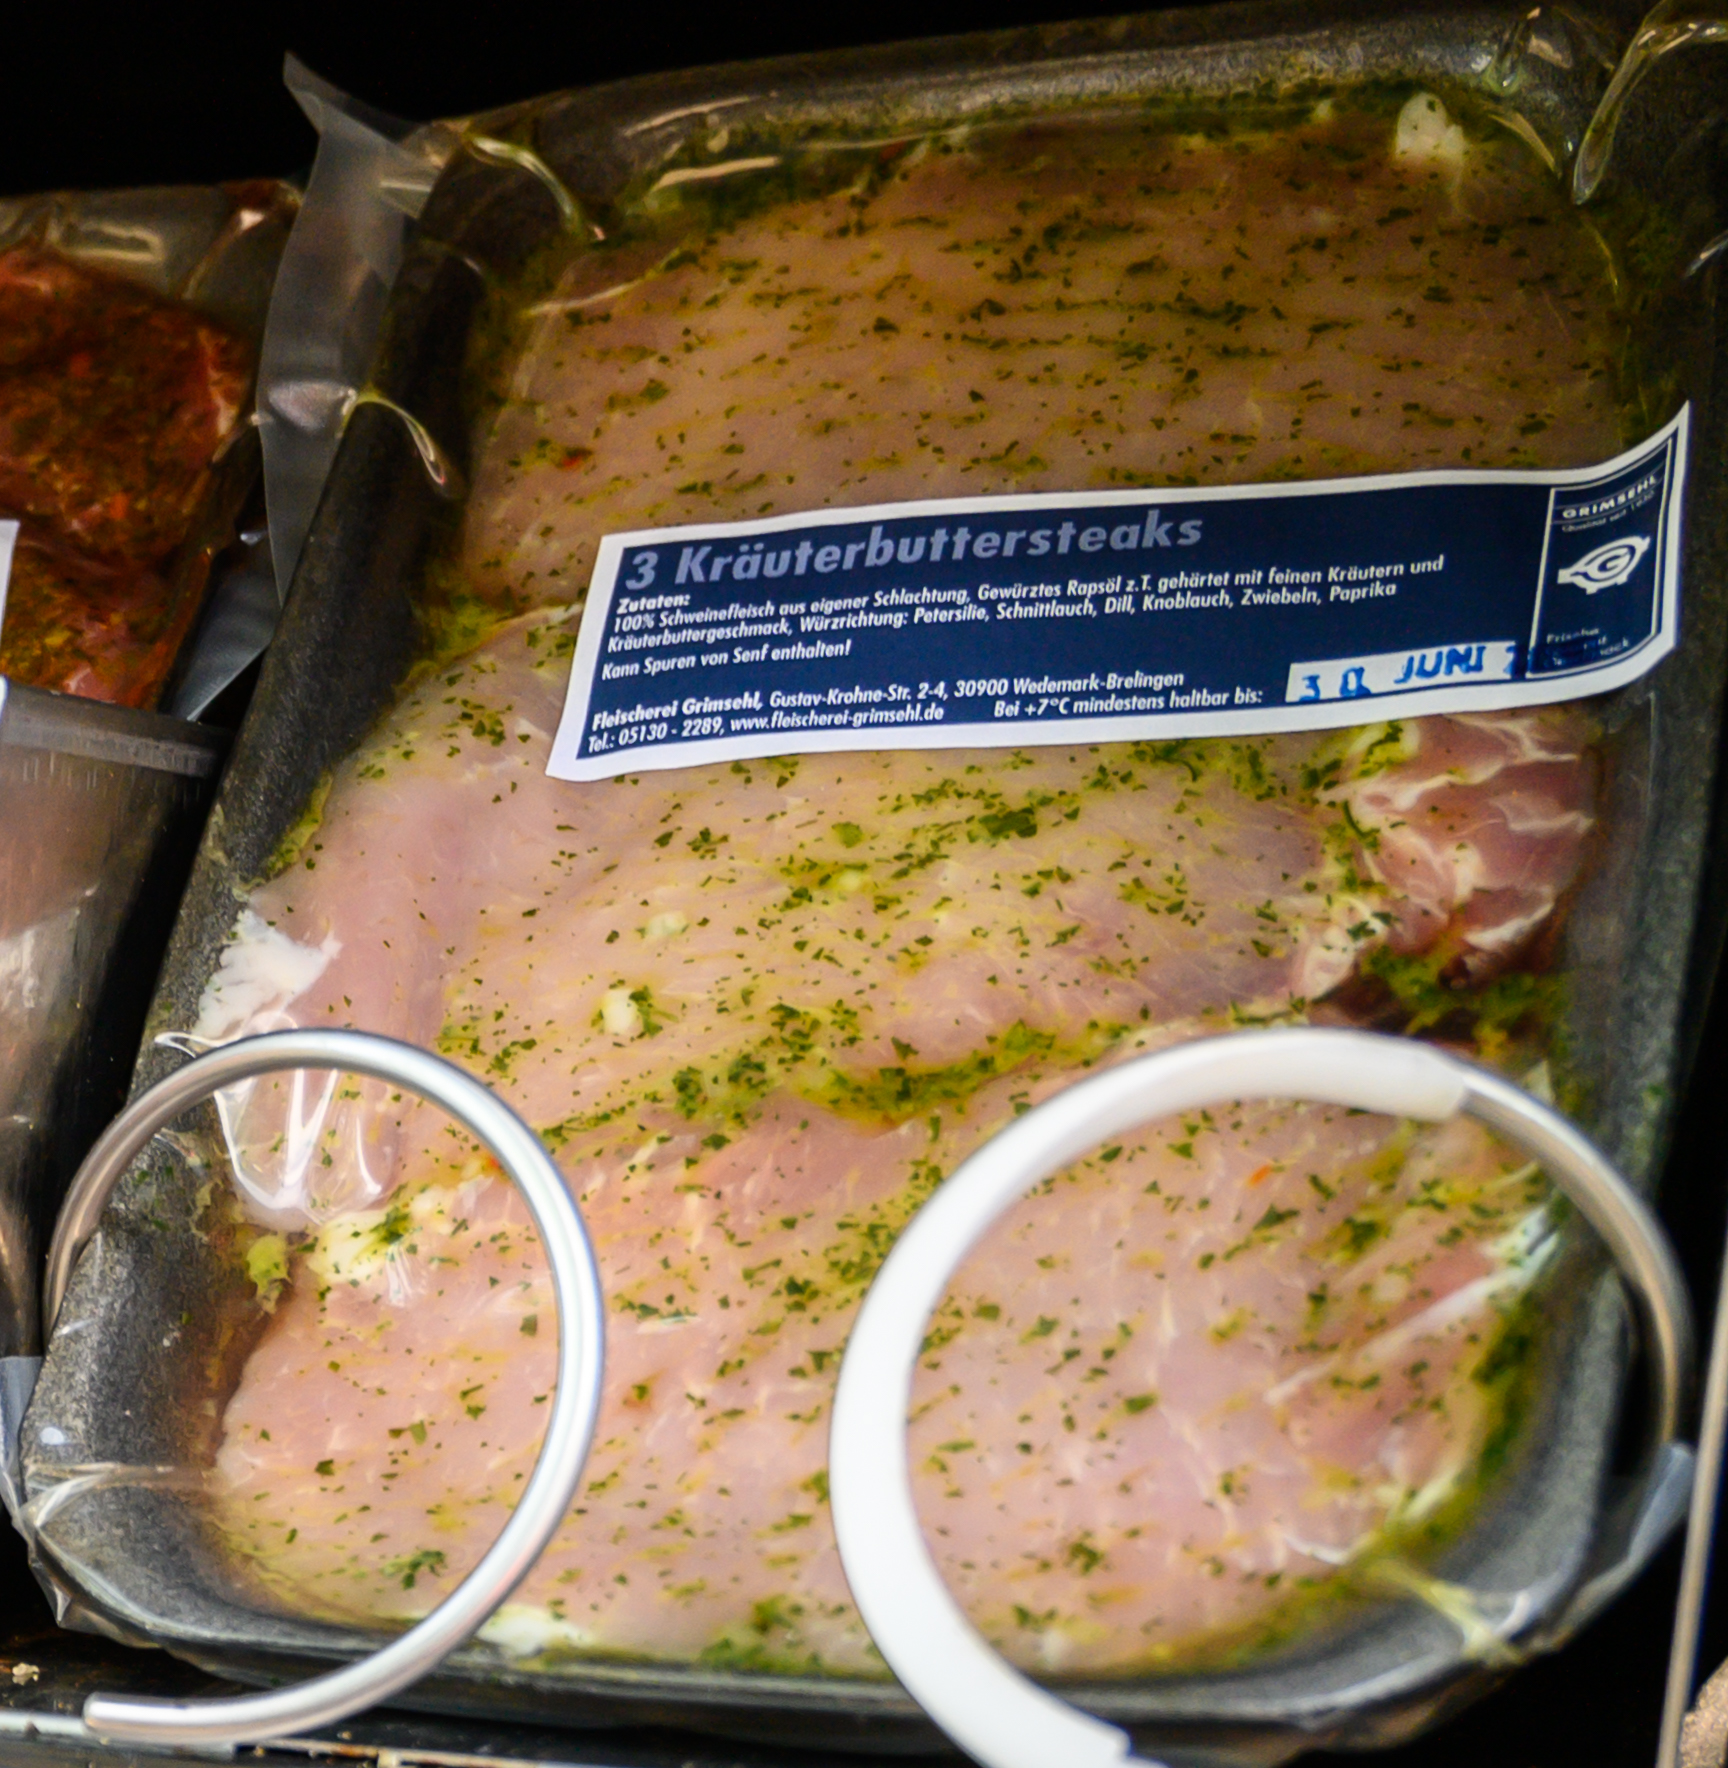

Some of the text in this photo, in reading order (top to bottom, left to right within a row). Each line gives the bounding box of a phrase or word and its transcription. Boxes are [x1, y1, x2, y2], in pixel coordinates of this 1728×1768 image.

[1562, 474, 1657, 519] GRIMSEHL
[626, 509, 1203, 590] 3 Kräuterbuttersteaks
[607, 581, 1396, 653] Kräuterbuttergeschmack, Würzrichtung: Petersilie, Schnittlauch, Dill, Knoblauch, Zwiebeln, Paprika
[614, 613, 655, 633] 100%
[659, 602, 774, 629] Schweinefleisch
[780, 601, 805, 616] aus
[810, 595, 869, 615] eigener
[873, 586, 971, 607] Schlachtung,
[978, 582, 1061, 601] Gewürztes
[1067, 575, 1122, 600] Rapsöl
[1158, 569, 1230, 594] gehärtet
[1234, 569, 1262, 586] mit
[1268, 567, 1322, 584] feinen
[1328, 563, 1405, 582] Kräutern
[1410, 554, 1444, 574] und
[616, 593, 691, 614] Zutaten:
[602, 639, 851, 680] Kann Spuren von Senf enthalten!
[1393, 644, 1486, 684] JUNI
[588, 730, 614, 754] Tel.:
[618, 721, 666, 747] 05130
[681, 716, 725, 738] 2289,
[730, 702, 944, 732] www.fleischerei-grimsehl.de
[994, 700, 1019, 718] Bei
[1073, 693, 1165, 714] mindestens
[1169, 687, 1228, 709] haltbar
[1234, 687, 1263, 704] bis:
[592, 699, 677, 732] Fleischerei
[770, 684, 912, 708] Gustav-Krohne-Str.
[917, 681, 948, 701] 2-4,
[954, 678, 1008, 698] 30900
[1013, 670, 1184, 695] Wedemark-Brelingen
